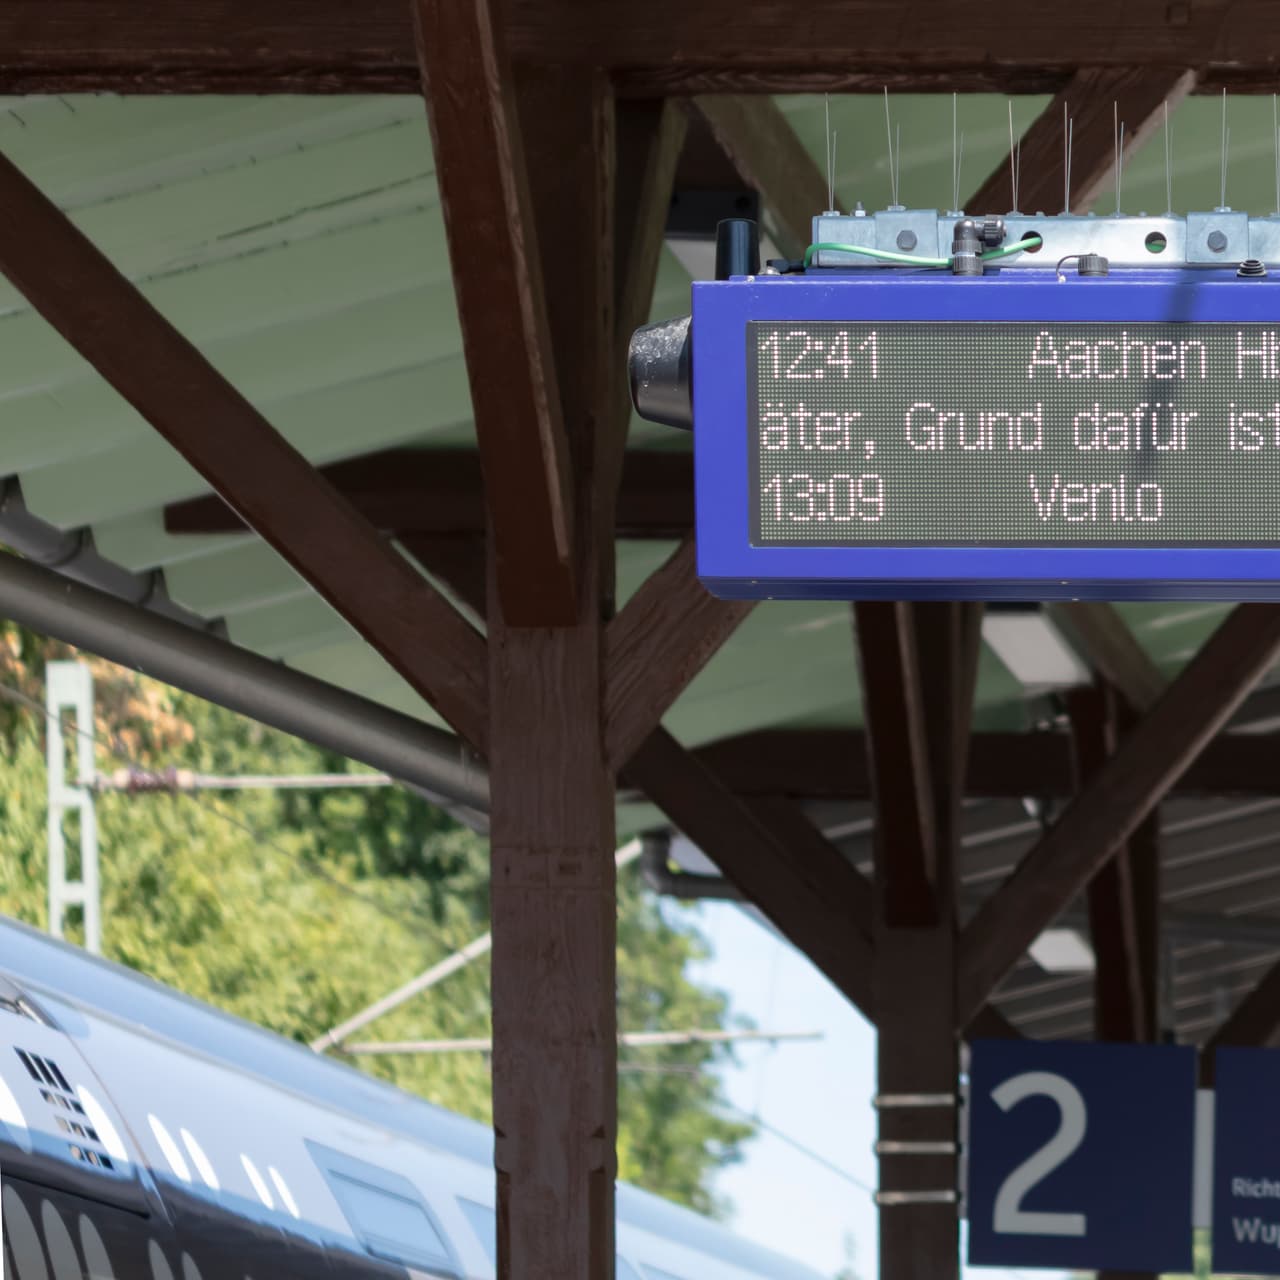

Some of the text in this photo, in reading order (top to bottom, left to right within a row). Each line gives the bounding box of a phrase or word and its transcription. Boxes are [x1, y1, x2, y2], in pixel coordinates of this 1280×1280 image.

[760, 330, 879, 379] 12:41
[1028, 330, 1206, 379] Aachen
[761, 402, 876, 460] äter,
[904, 402, 1043, 452] Grund
[1074, 402, 1198, 452] dafür
[762, 473, 885, 523] 13:09
[1029, 473, 1163, 523] Venlo
[990, 1071, 1087, 1236] 2
